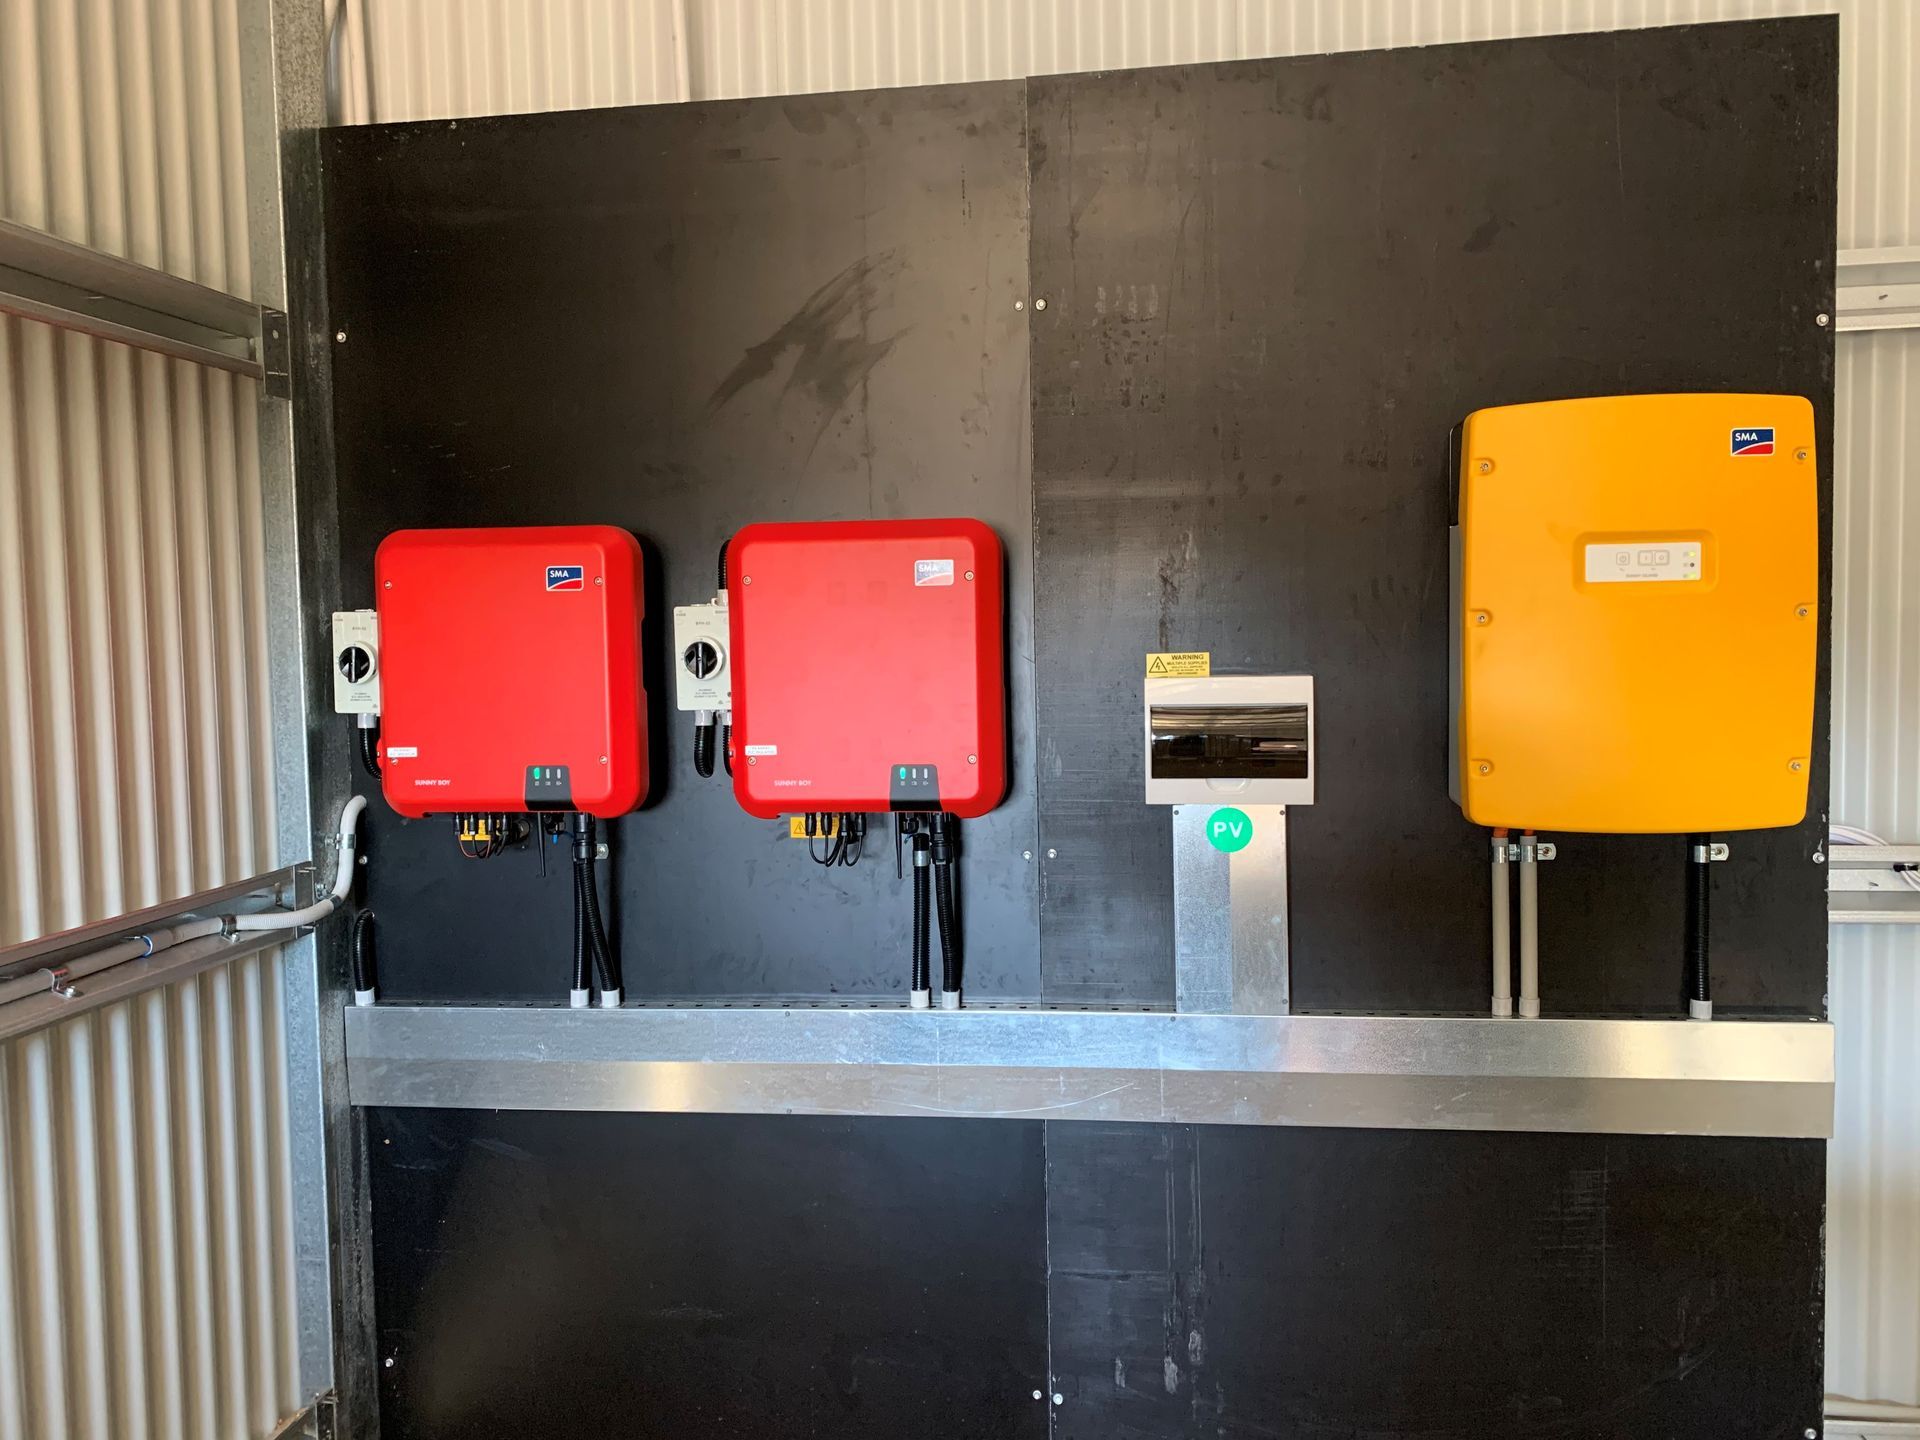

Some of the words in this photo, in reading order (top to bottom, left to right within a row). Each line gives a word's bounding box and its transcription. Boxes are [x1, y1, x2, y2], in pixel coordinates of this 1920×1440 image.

[1735, 432, 1758, 441] SMA
[918, 564, 939, 572] SMA
[550, 570, 569, 578] SMA
[1213, 821, 1244, 838] PV
